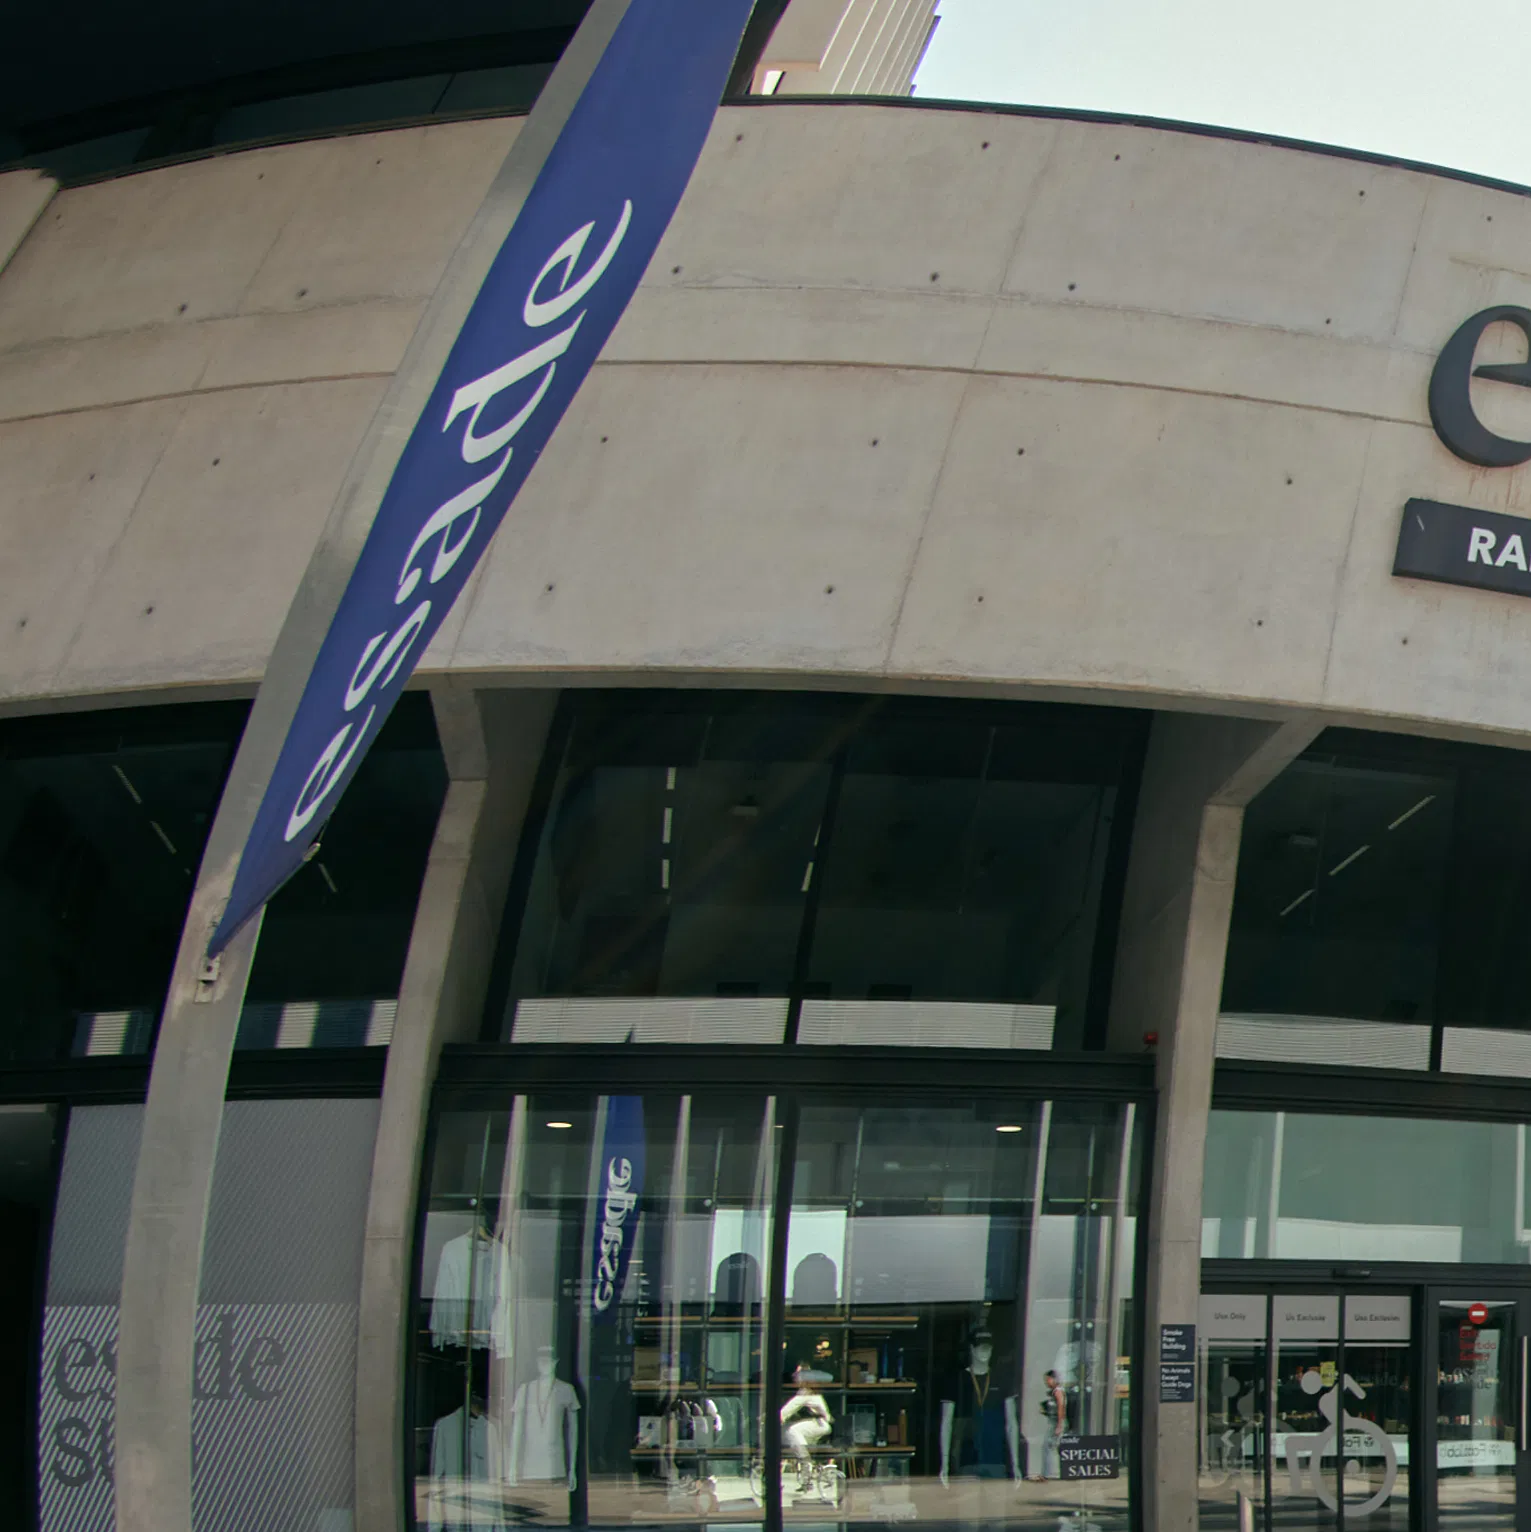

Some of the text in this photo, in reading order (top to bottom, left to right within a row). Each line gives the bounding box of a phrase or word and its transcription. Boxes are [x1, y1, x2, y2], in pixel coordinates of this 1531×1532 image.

[284, 199, 632, 842] esade
[1061, 1449, 1118, 1460] SPECIAL
[1068, 1465, 1111, 1476] SALES
